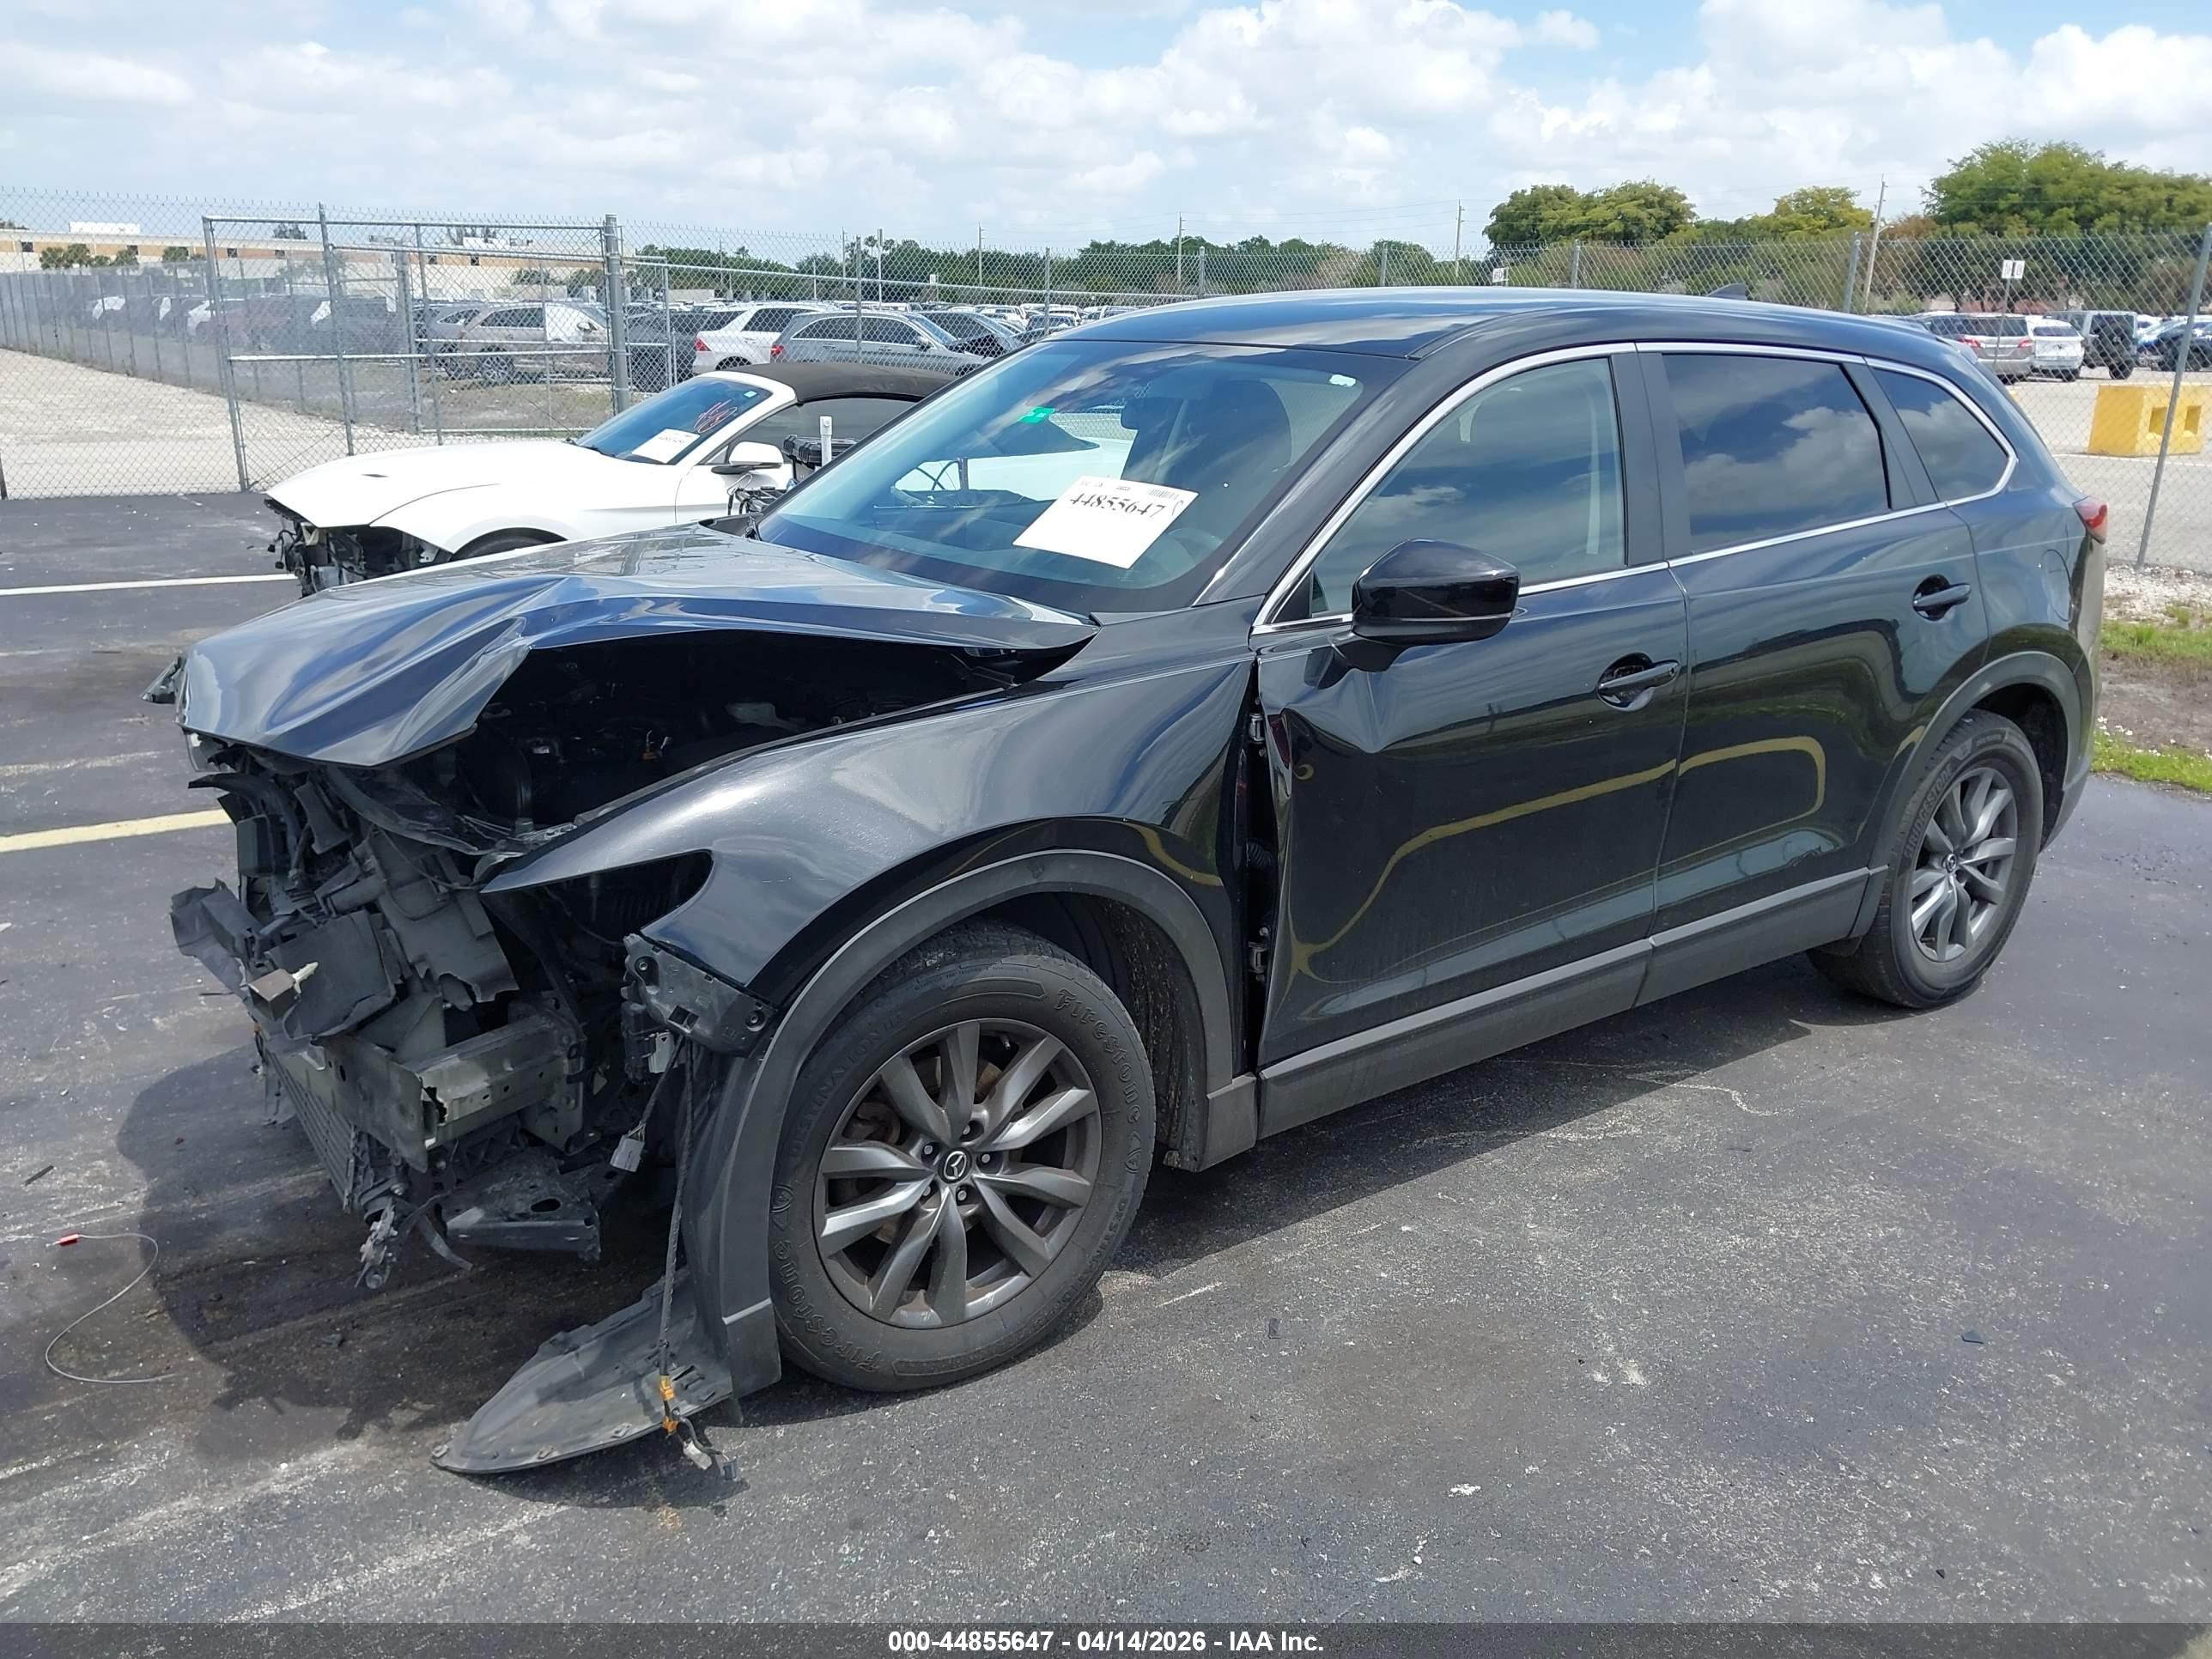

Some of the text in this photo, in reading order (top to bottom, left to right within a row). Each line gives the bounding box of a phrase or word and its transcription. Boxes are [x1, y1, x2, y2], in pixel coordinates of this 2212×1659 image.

[1069, 492, 1167, 519] 44855647
[1054, 988, 1142, 1125] Firestone
[772, 1238, 883, 1374] Firestone
